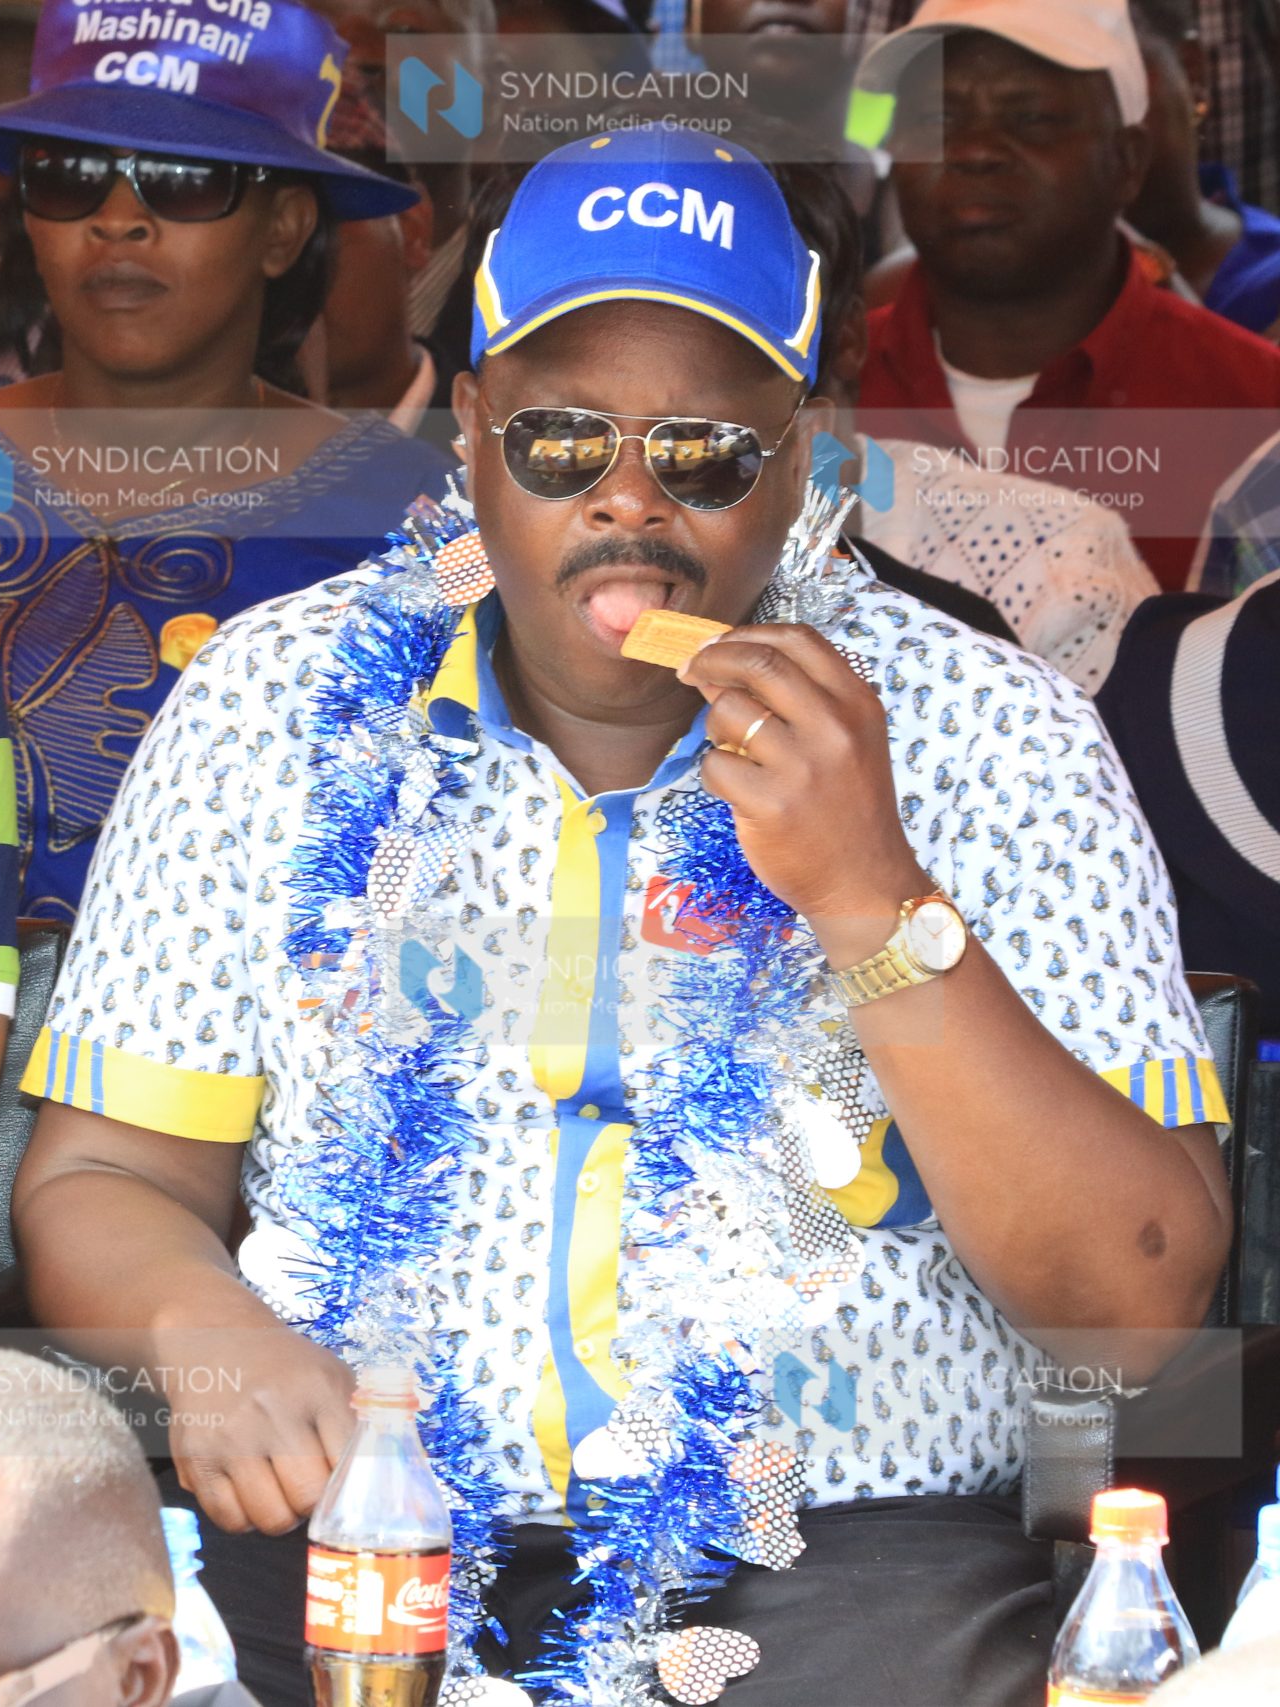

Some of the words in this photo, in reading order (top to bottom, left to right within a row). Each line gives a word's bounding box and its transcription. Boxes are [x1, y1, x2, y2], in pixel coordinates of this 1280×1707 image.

[73, 8, 254, 65] Mashinani
[94, 51, 200, 94] CCM
[577, 181, 735, 251] CCM
